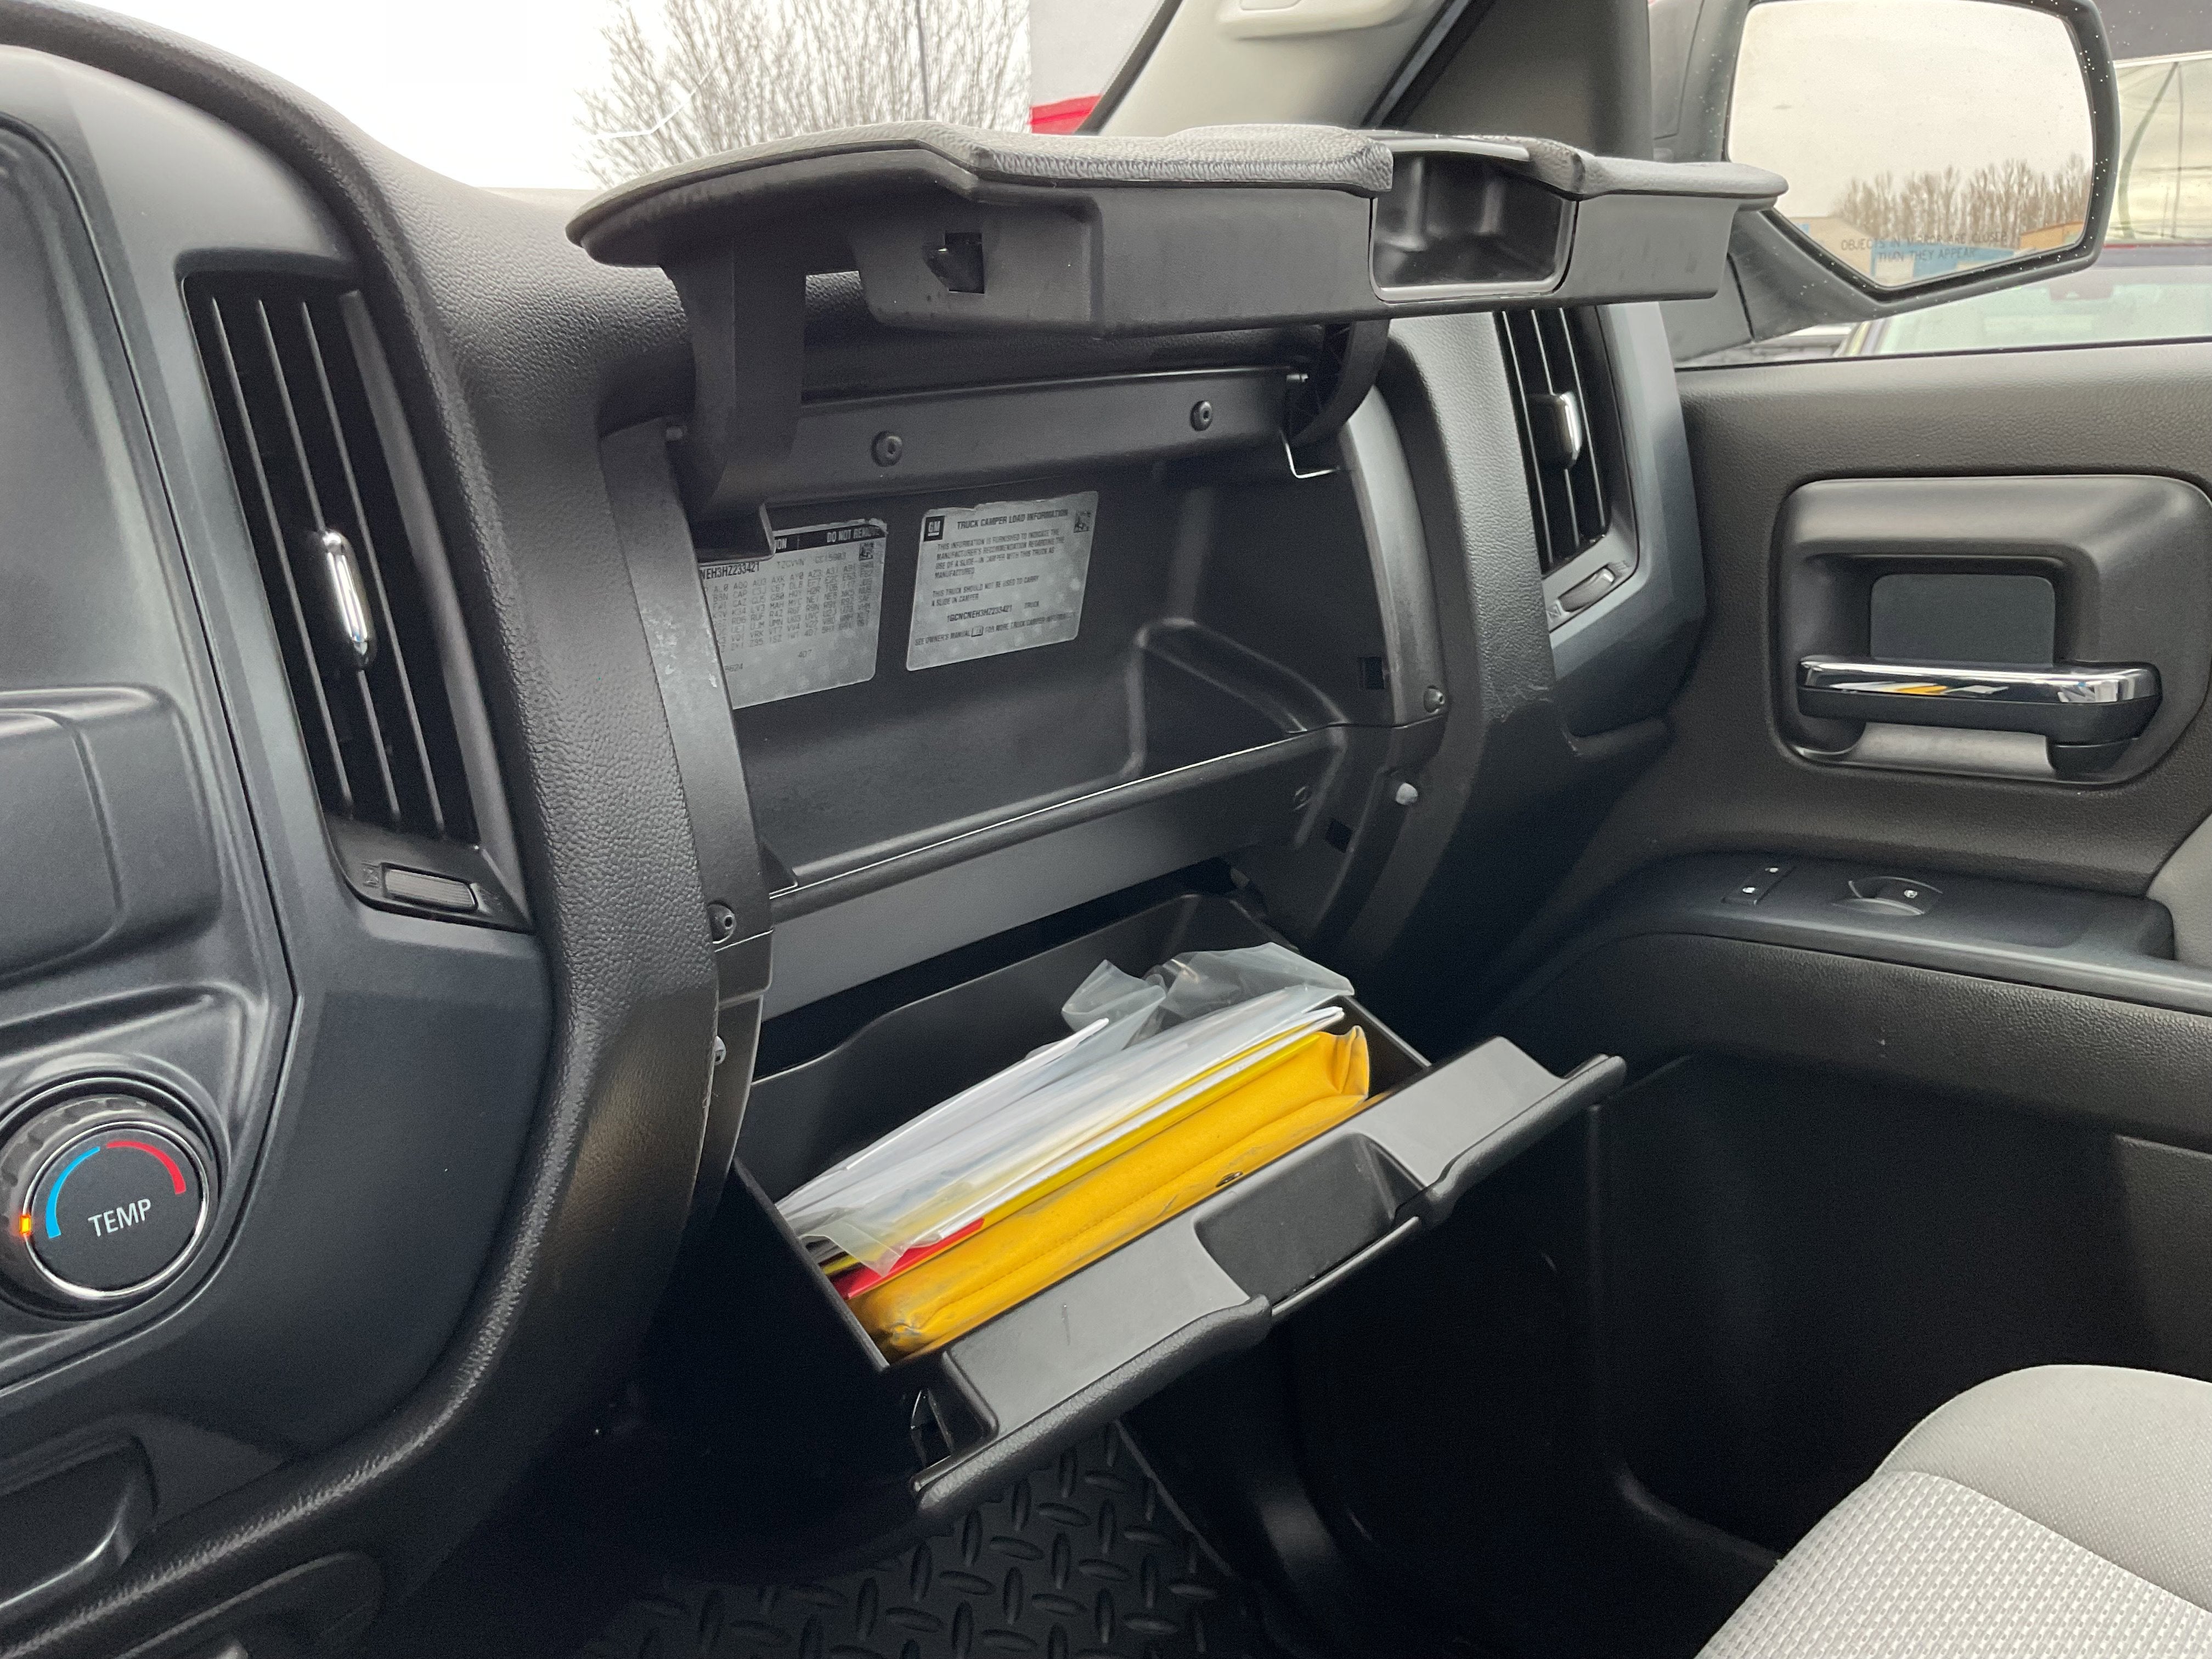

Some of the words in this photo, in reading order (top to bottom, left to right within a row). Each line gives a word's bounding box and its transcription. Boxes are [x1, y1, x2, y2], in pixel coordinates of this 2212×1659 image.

[1841, 238, 1885, 251] OBJECTS
[1892, 237, 1900, 247] IN
[1907, 234, 1942, 246] MIRROR
[1972, 232, 2007, 243] CLOSER
[1878, 251, 1904, 262] THAN
[1910, 250, 1934, 261] THEY
[1938, 247, 1976, 260] APPEAR
[928, 520, 941, 532] GM
[957, 519, 978, 530] TRUCK
[980, 516, 1007, 527] CAMPER
[1008, 514, 1025, 523] LOAD
[1027, 509, 1068, 520] INFORMATION
[775, 537, 787, 550] ON
[827, 531, 837, 543] DO
[838, 529, 851, 540] NOT
[938, 543, 949, 551] THIS
[951, 539, 984, 549] INFORMATION
[983, 542, 1026, 554] RECOMMENDATION
[1028, 538, 1054, 548] REGARDING
[946, 560, 953, 568] OF
[1006, 551, 1018, 560] WITH
[1020, 550, 1031, 558] THIS
[1032, 547, 1047, 556] TRUCK
[933, 589, 944, 597] THIS
[945, 586, 961, 595] TRUCK
[963, 583, 983, 592] SHOULD
[1002, 578, 1015, 587] USED
[1024, 575, 1039, 584] CARRY
[936, 597, 950, 606] SLIDE
[1024, 601, 1039, 609] TRUCK
[915, 637, 924, 646] SEE
[926, 633, 949, 644] OWNER'S
[950, 630, 970, 639] MANUAL
[995, 623, 1009, 631] MORE
[1011, 620, 1025, 629] TRUCK
[87, 1198, 152, 1238] TEMP
